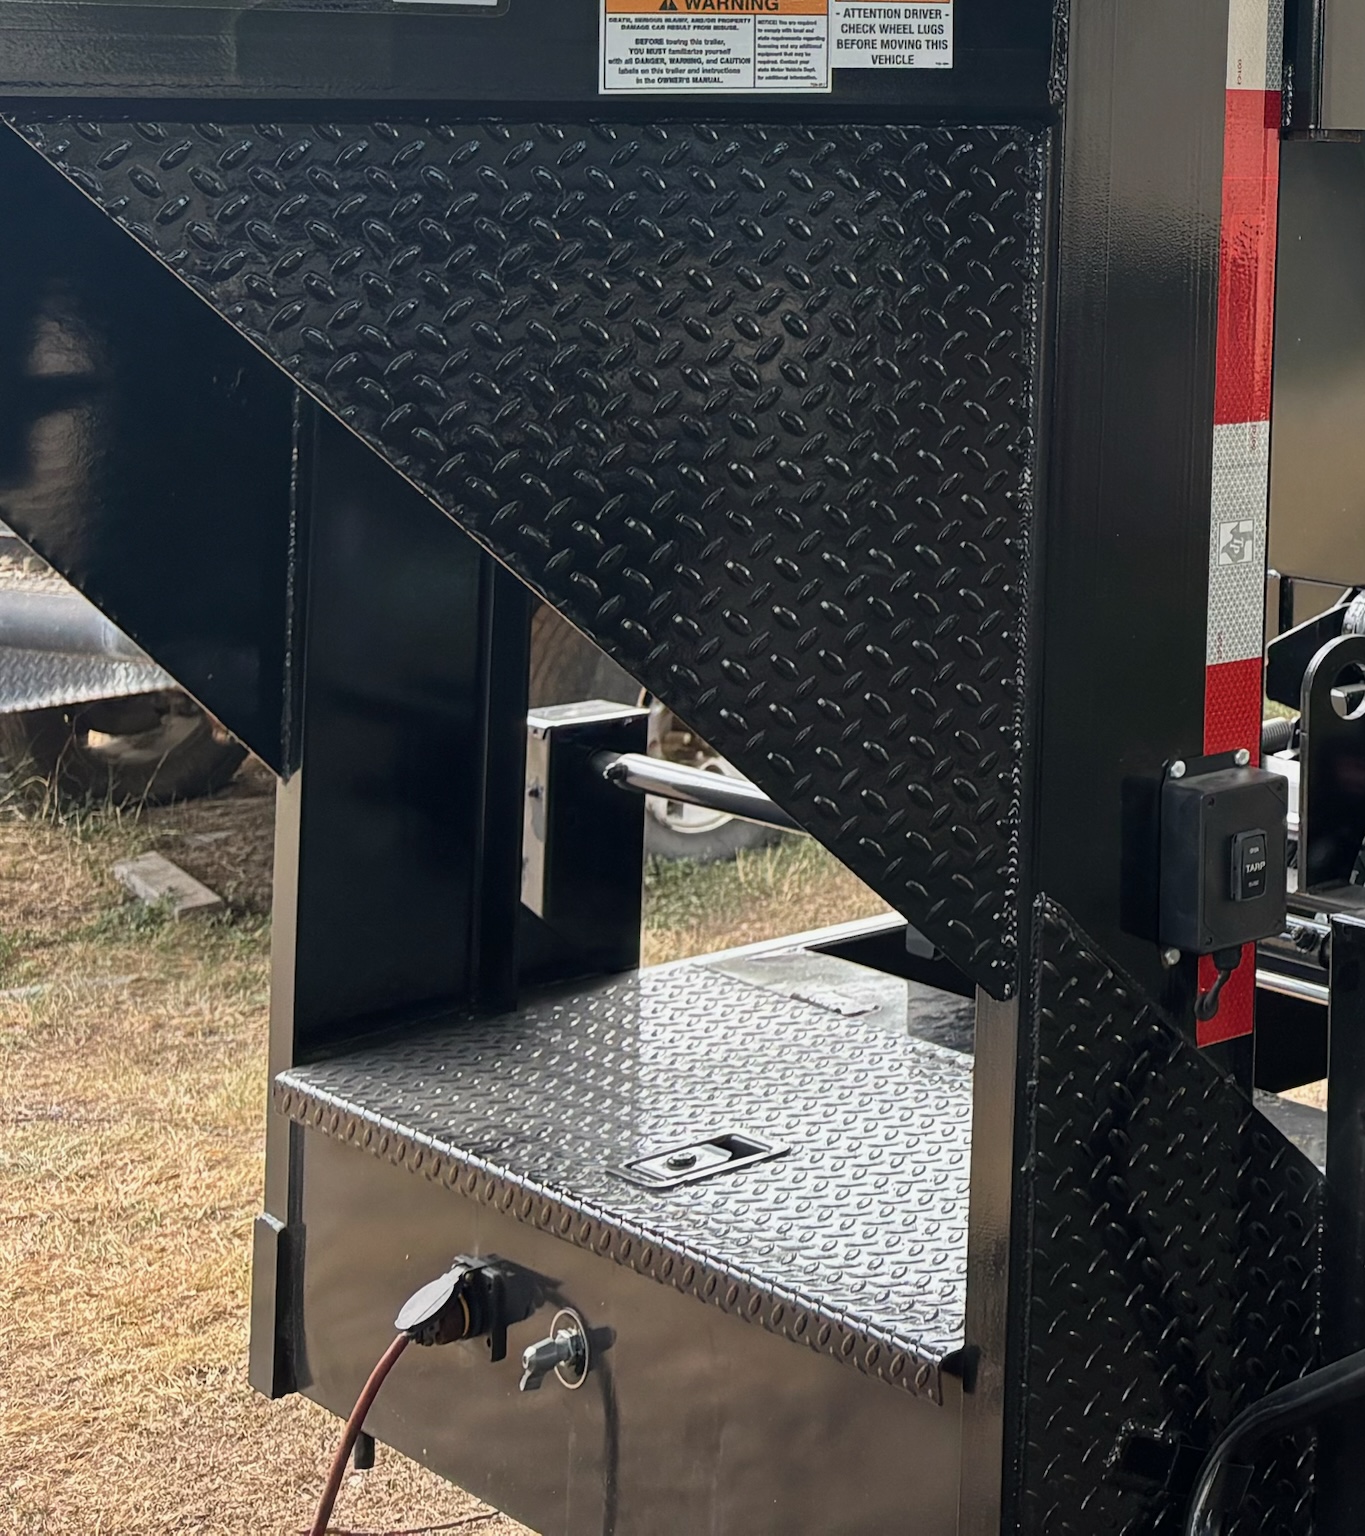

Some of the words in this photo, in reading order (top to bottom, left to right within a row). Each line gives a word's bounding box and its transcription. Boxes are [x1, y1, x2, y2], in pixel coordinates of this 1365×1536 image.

[843, 8, 901, 19] ATTENTION
[904, 9, 942, 19] DRIVER
[841, 23, 876, 34] CHECK
[879, 24, 915, 35] WHEEL
[918, 24, 944, 35] LUGS
[836, 39, 877, 49] BEFORE
[880, 39, 922, 49] MOVING
[924, 39, 949, 50] THIS
[871, 54, 915, 65] VEHICLE
[1245, 860, 1266, 874] TARP
